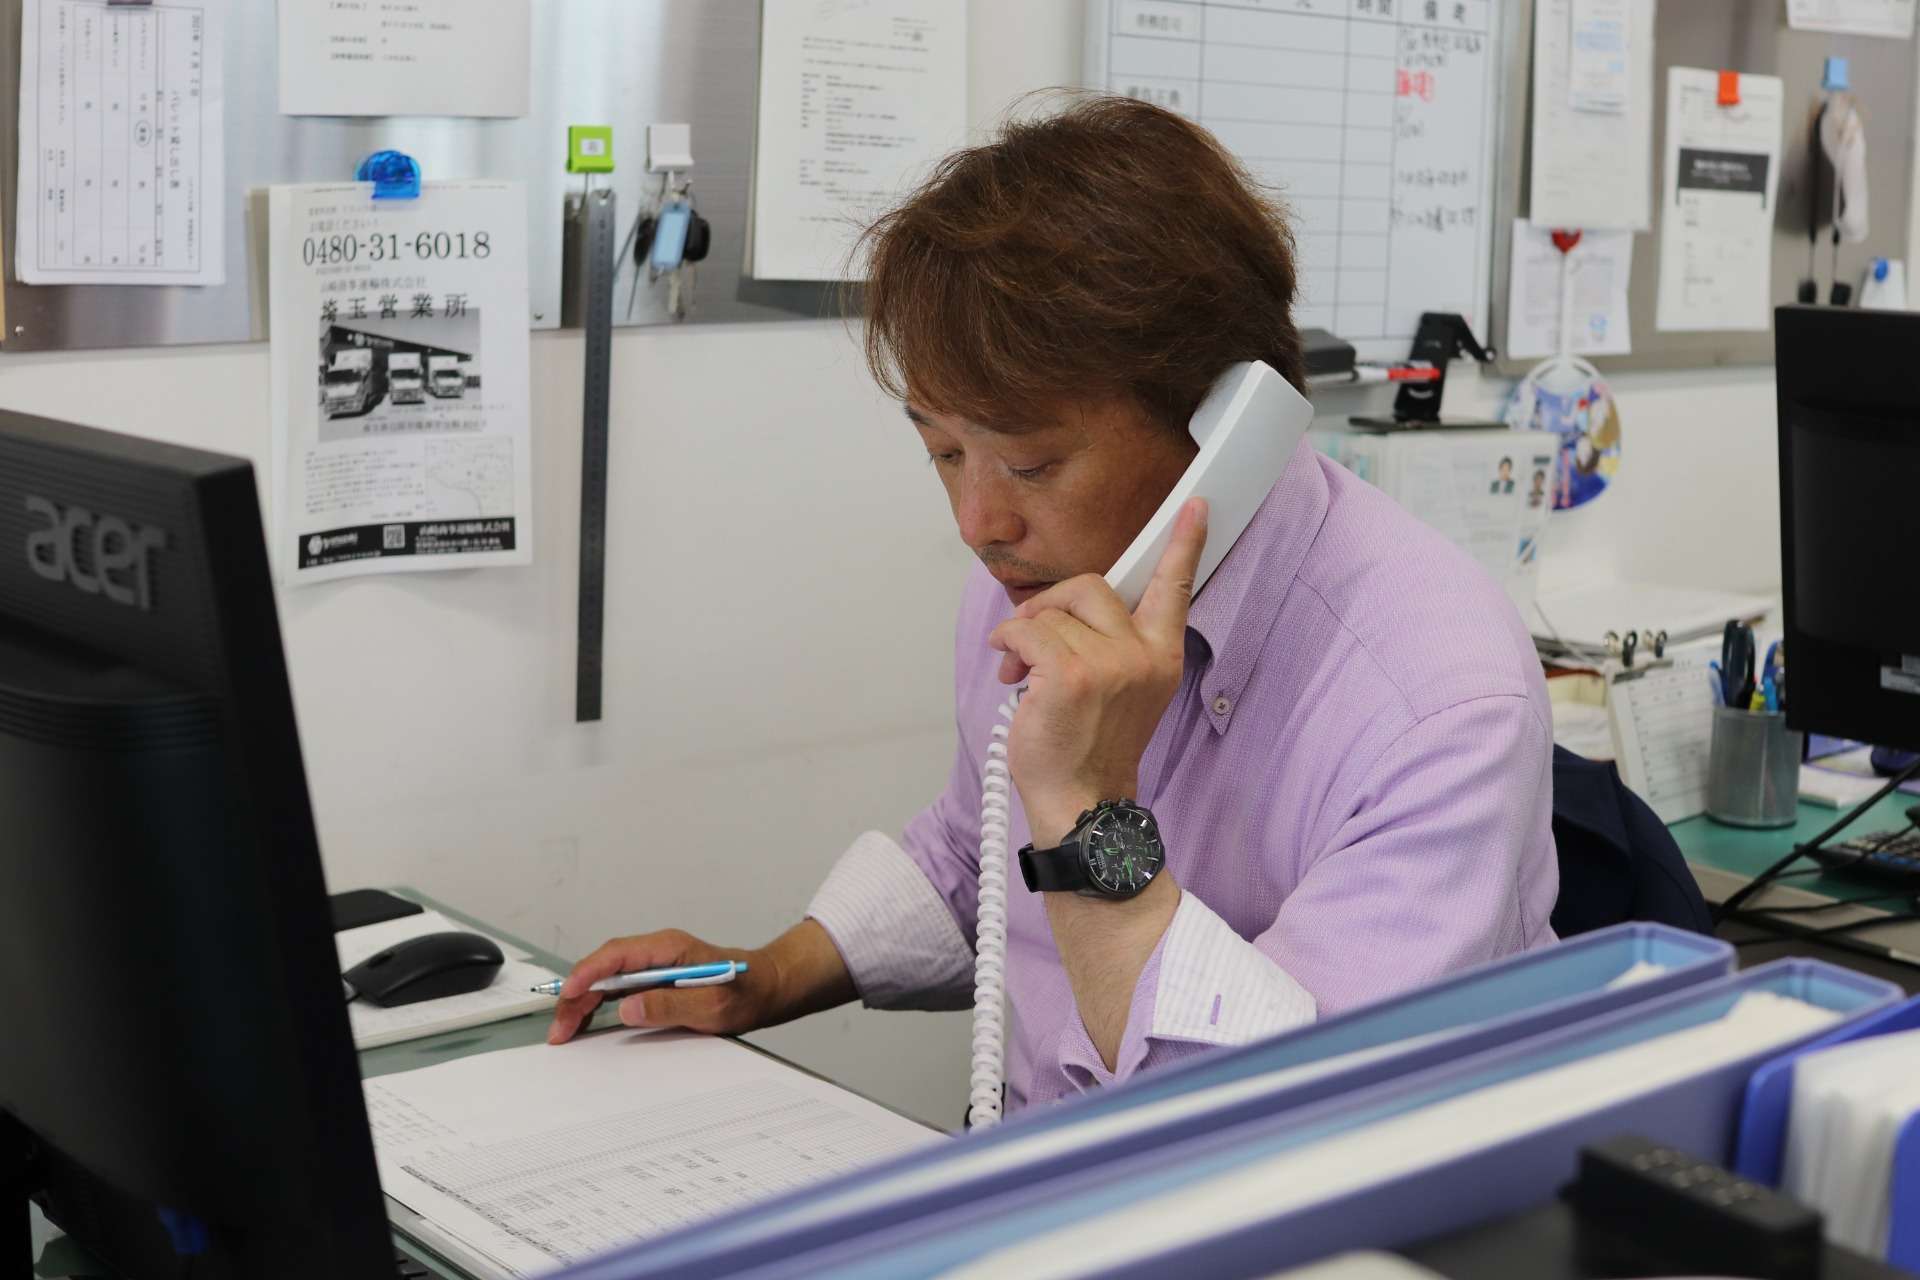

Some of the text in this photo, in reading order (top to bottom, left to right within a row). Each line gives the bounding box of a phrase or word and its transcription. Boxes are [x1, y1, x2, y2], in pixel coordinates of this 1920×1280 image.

[303, 231, 491, 266] 0480-31-6018
[320, 293, 468, 323] 埼玉営業所
[26, 495, 166, 611] acer
